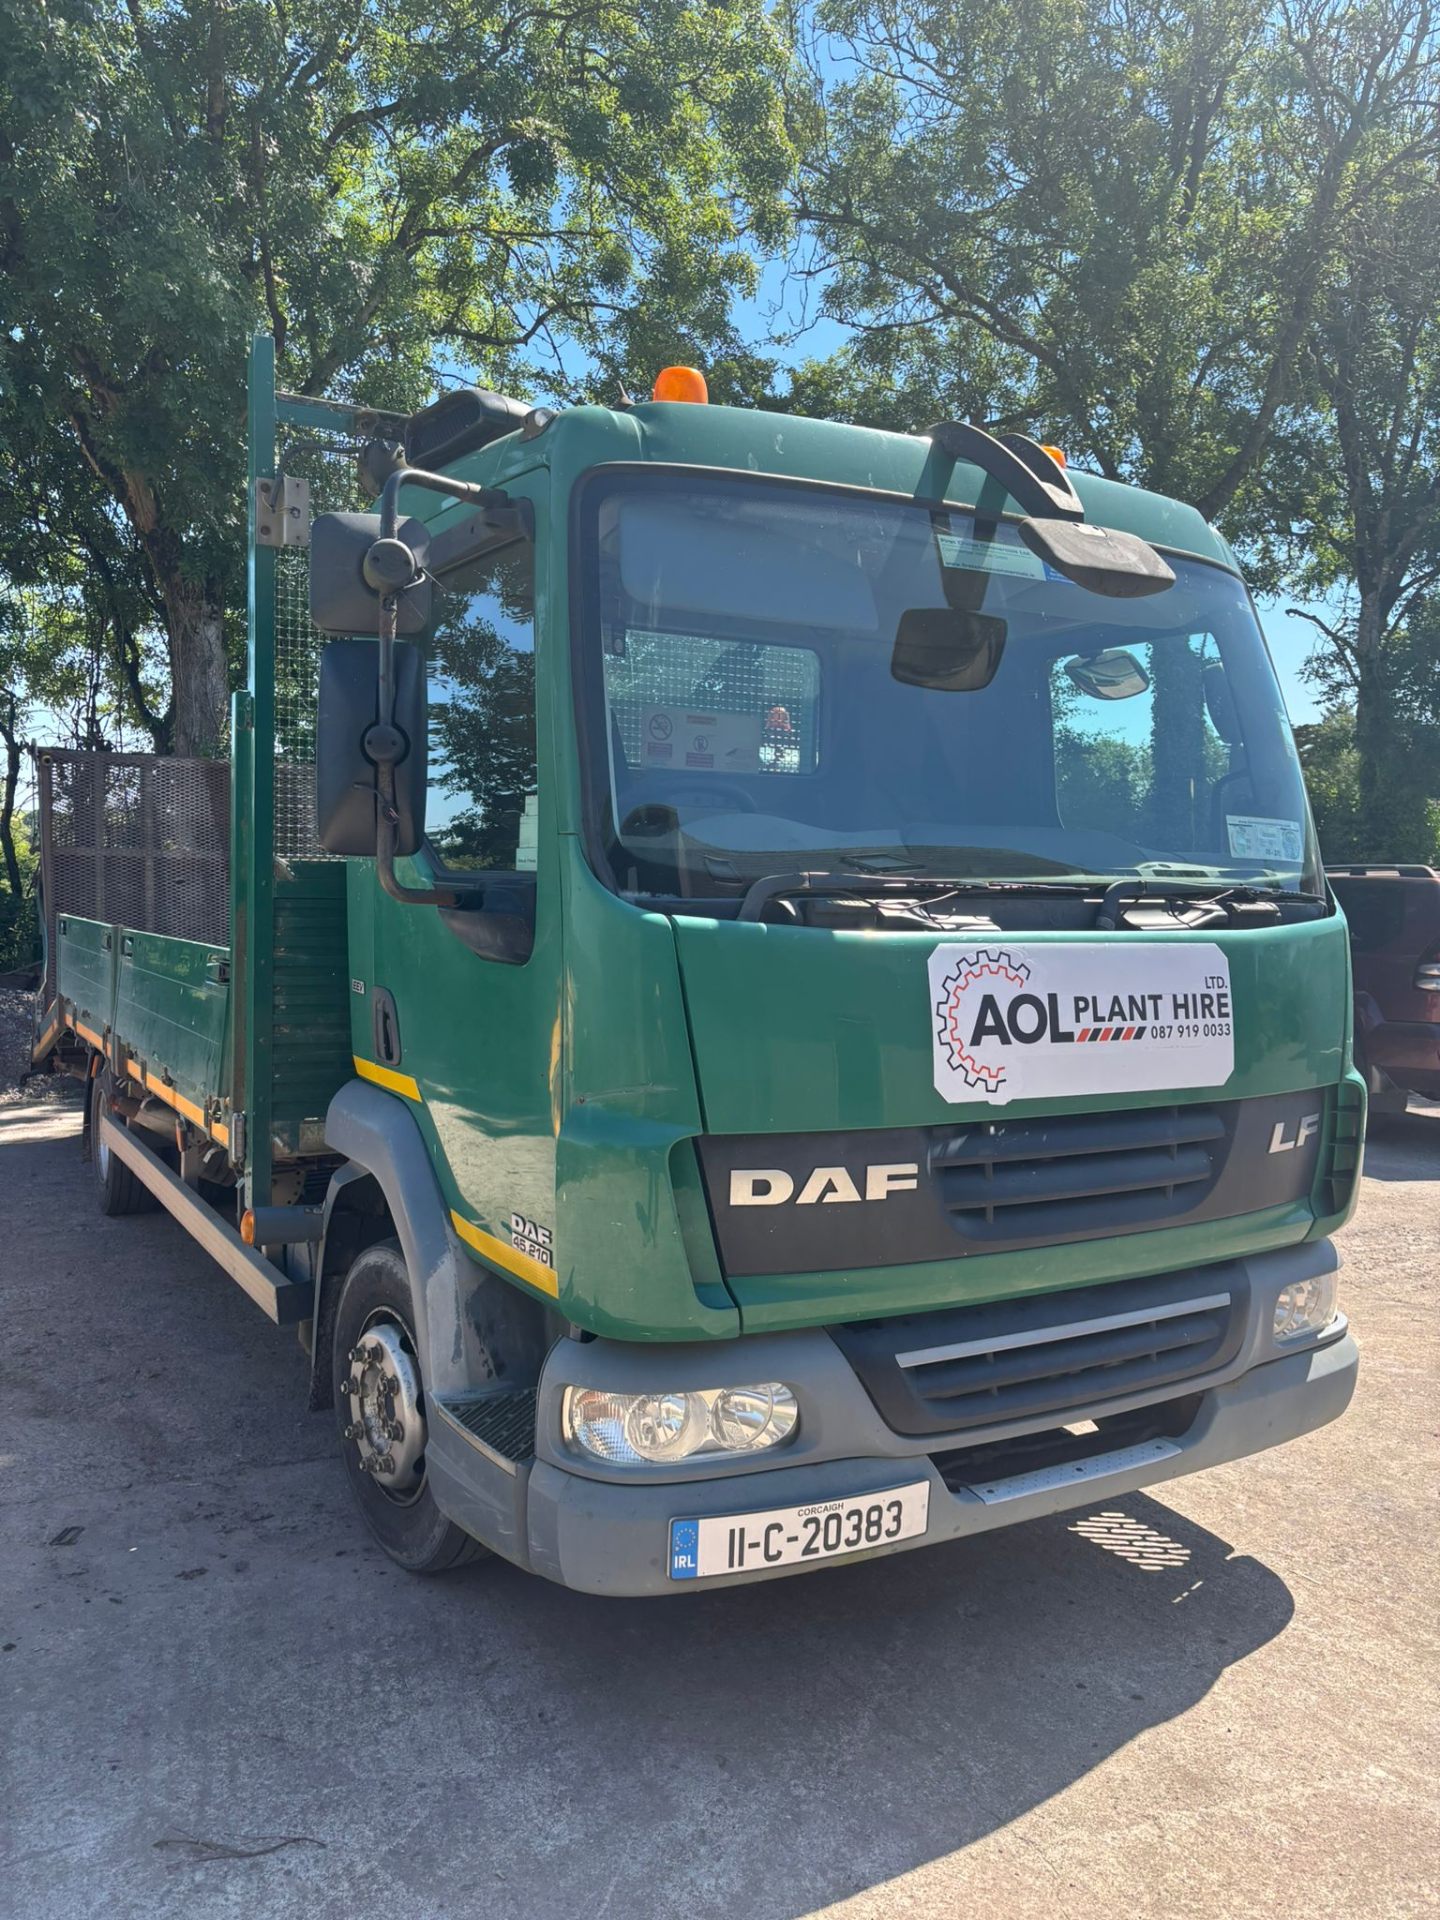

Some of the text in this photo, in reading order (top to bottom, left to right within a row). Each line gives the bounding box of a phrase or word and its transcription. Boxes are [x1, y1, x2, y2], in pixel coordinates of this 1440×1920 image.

[969, 992, 1230, 1046] AOL PLANT HIRE
[1150, 1023, 1231, 1039] 087 919 0033
[1267, 1113, 1320, 1154] LF
[729, 1163, 919, 1206] DAF
[511, 1212, 553, 1245] DAF
[797, 1501, 845, 1518] CORCAIGH
[727, 1499, 904, 1569] 11-C-20383
[674, 1554, 696, 1569] IRL
